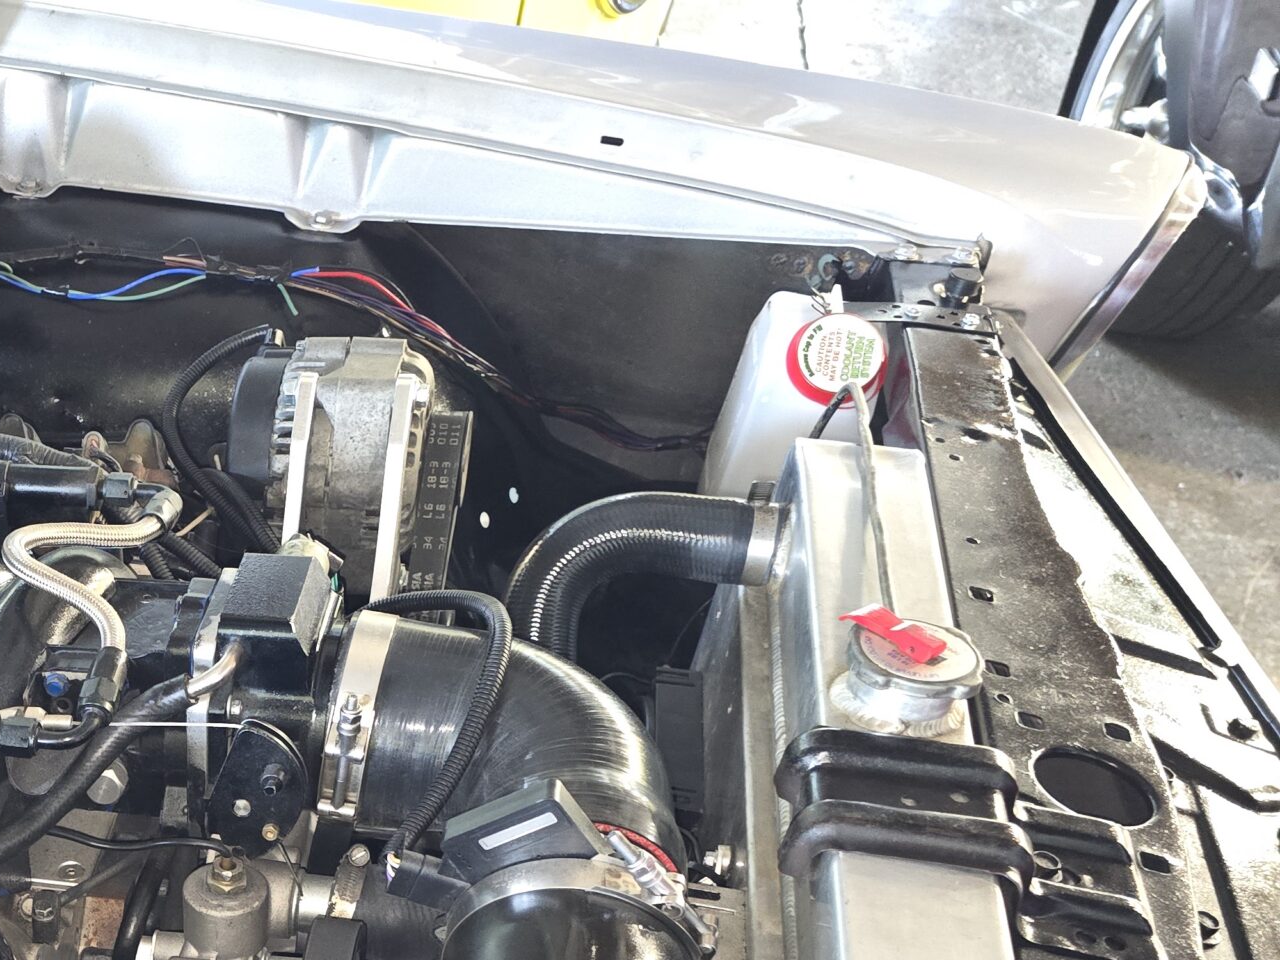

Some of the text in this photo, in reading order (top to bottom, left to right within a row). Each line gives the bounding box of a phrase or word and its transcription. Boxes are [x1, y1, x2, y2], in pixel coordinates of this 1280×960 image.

[803, 341, 811, 352] Cap
[815, 335, 827, 372] CAUTION
[822, 331, 835, 376] CONTENTS
[832, 351, 840, 361] BE
[840, 330, 856, 382] COOLANT
[829, 364, 837, 381] MAY
